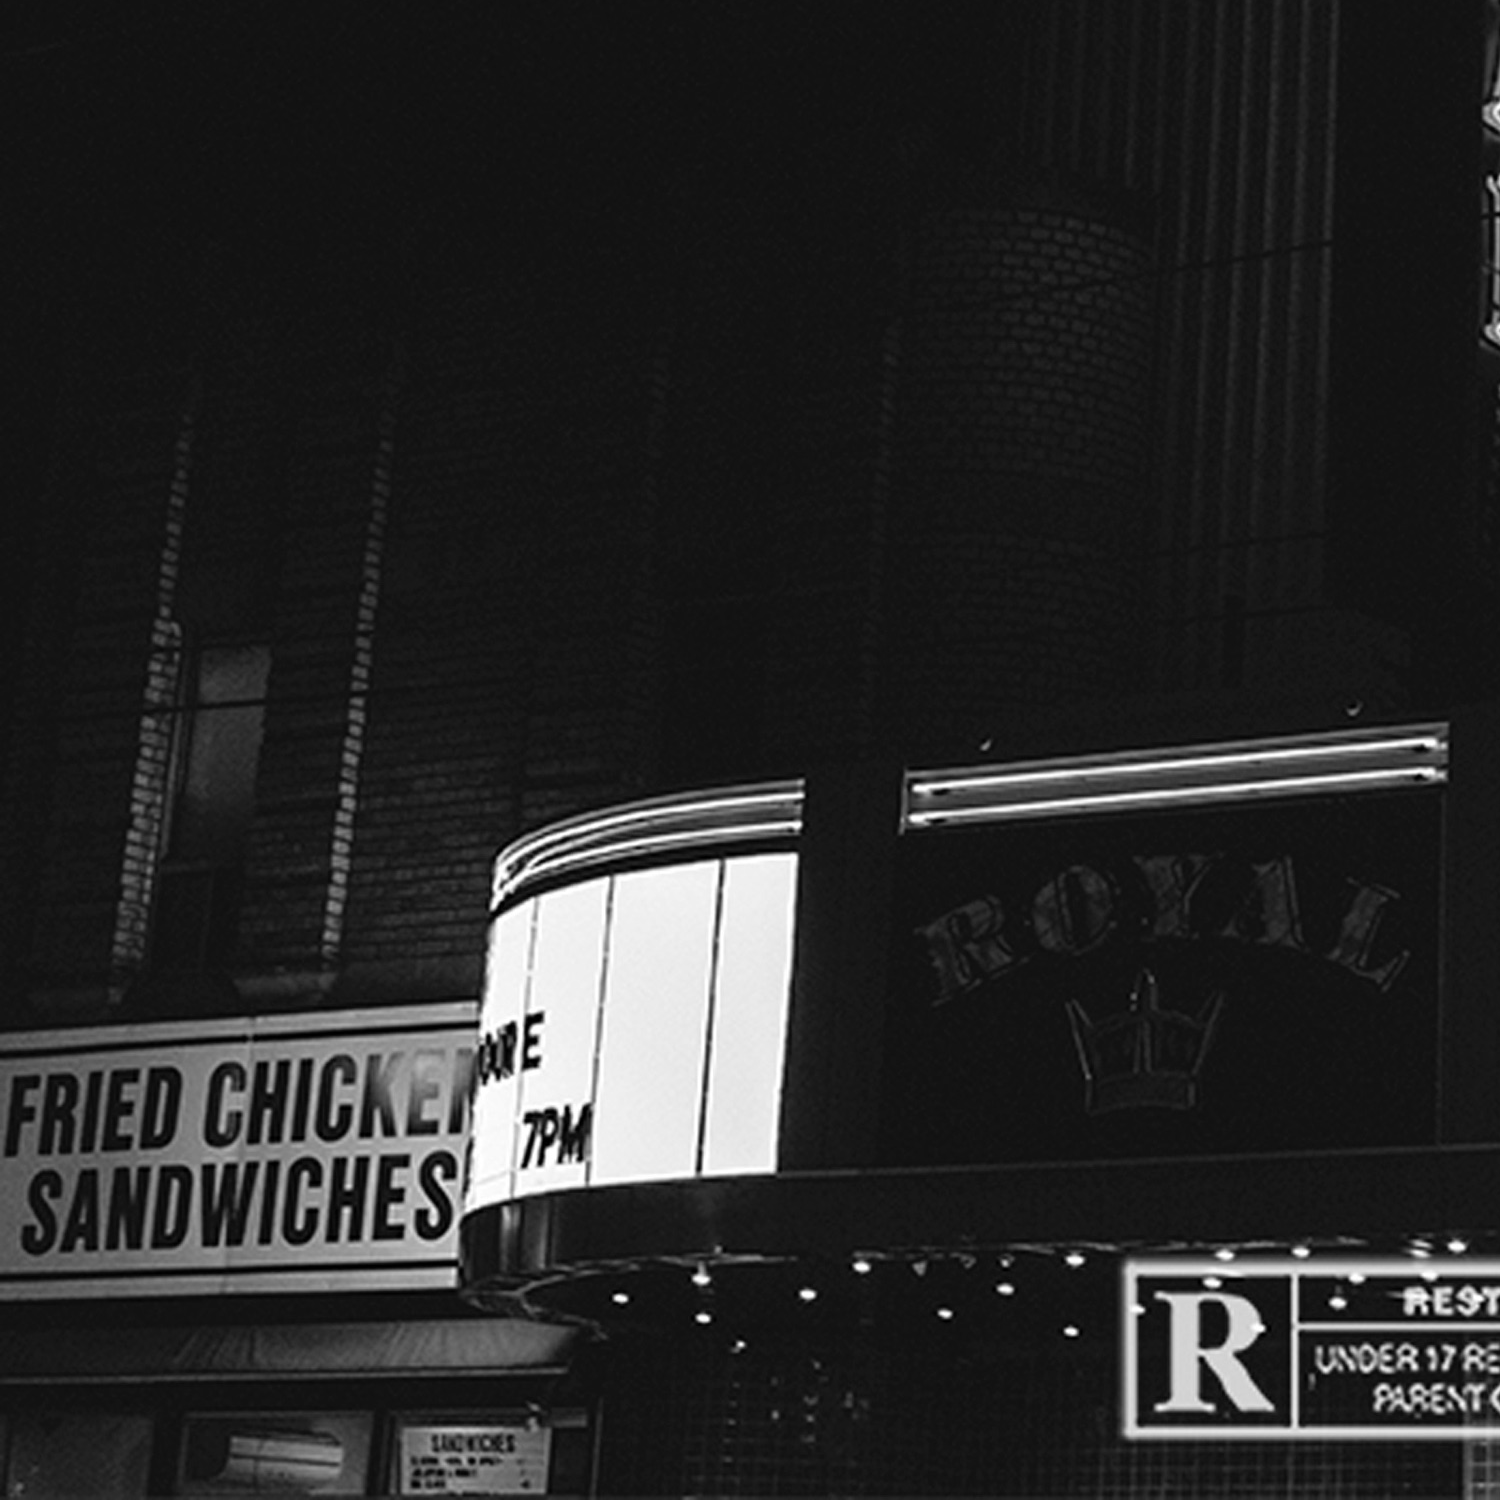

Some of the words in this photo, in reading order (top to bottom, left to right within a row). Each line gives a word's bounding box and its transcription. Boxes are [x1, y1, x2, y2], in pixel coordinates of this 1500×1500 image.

[914, 851, 1413, 1008] ROYAL
[4, 1065, 183, 1158] FRIED
[520, 1102, 594, 1170] 7PM
[21, 1151, 458, 1256] SANDWICHES
